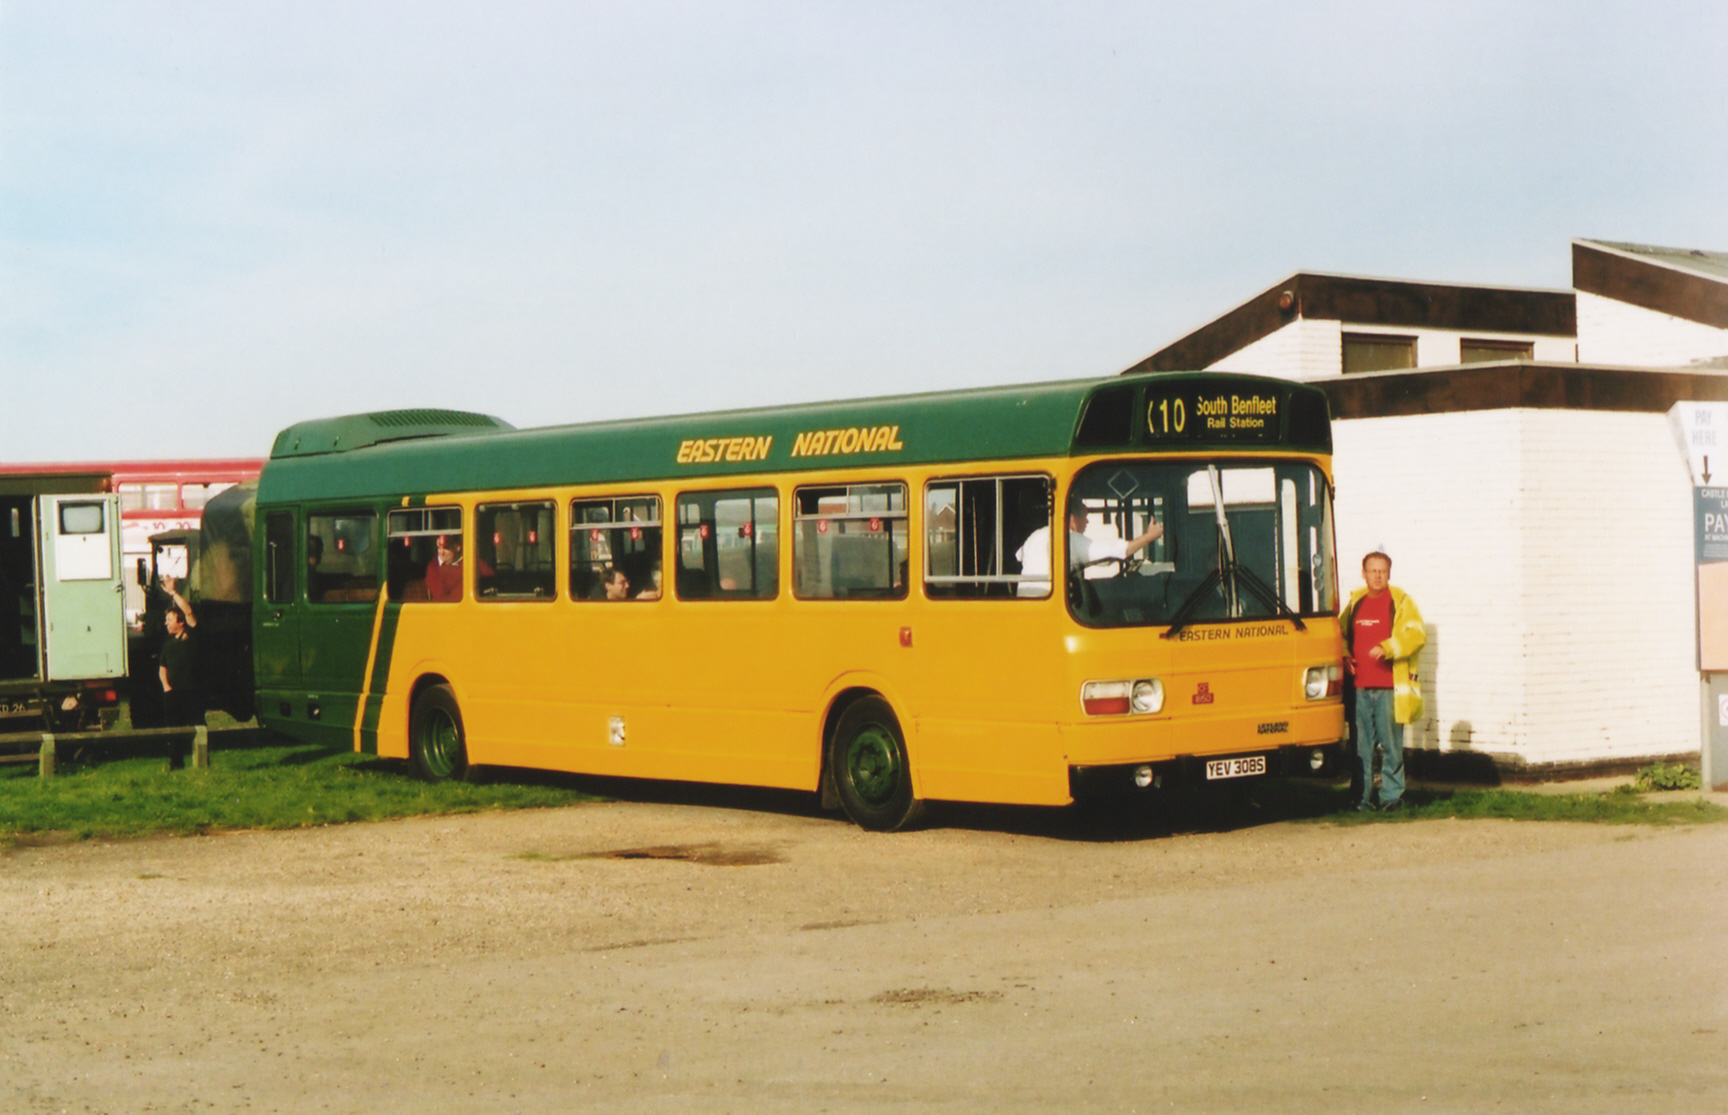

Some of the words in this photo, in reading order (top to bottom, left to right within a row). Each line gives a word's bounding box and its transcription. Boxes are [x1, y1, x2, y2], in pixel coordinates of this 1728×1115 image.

[1196, 395, 1228, 416] South
[1231, 395, 1277, 415] Benfleet
[1207, 417, 1226, 429] Rail
[1229, 417, 1264, 429] Station
[1694, 409, 1713, 426] PAY
[676, 435, 773, 464] EASTERN
[790, 425, 904, 457] NATIONAL
[1691, 429, 1718, 446] HERE
[1701, 488, 1725, 498] CASTLE
[1179, 628, 1231, 642] EASTERN
[1235, 625, 1289, 638] NATIONAL
[1208, 761, 1231, 777] YEV
[1234, 758, 1264, 774] 308S
